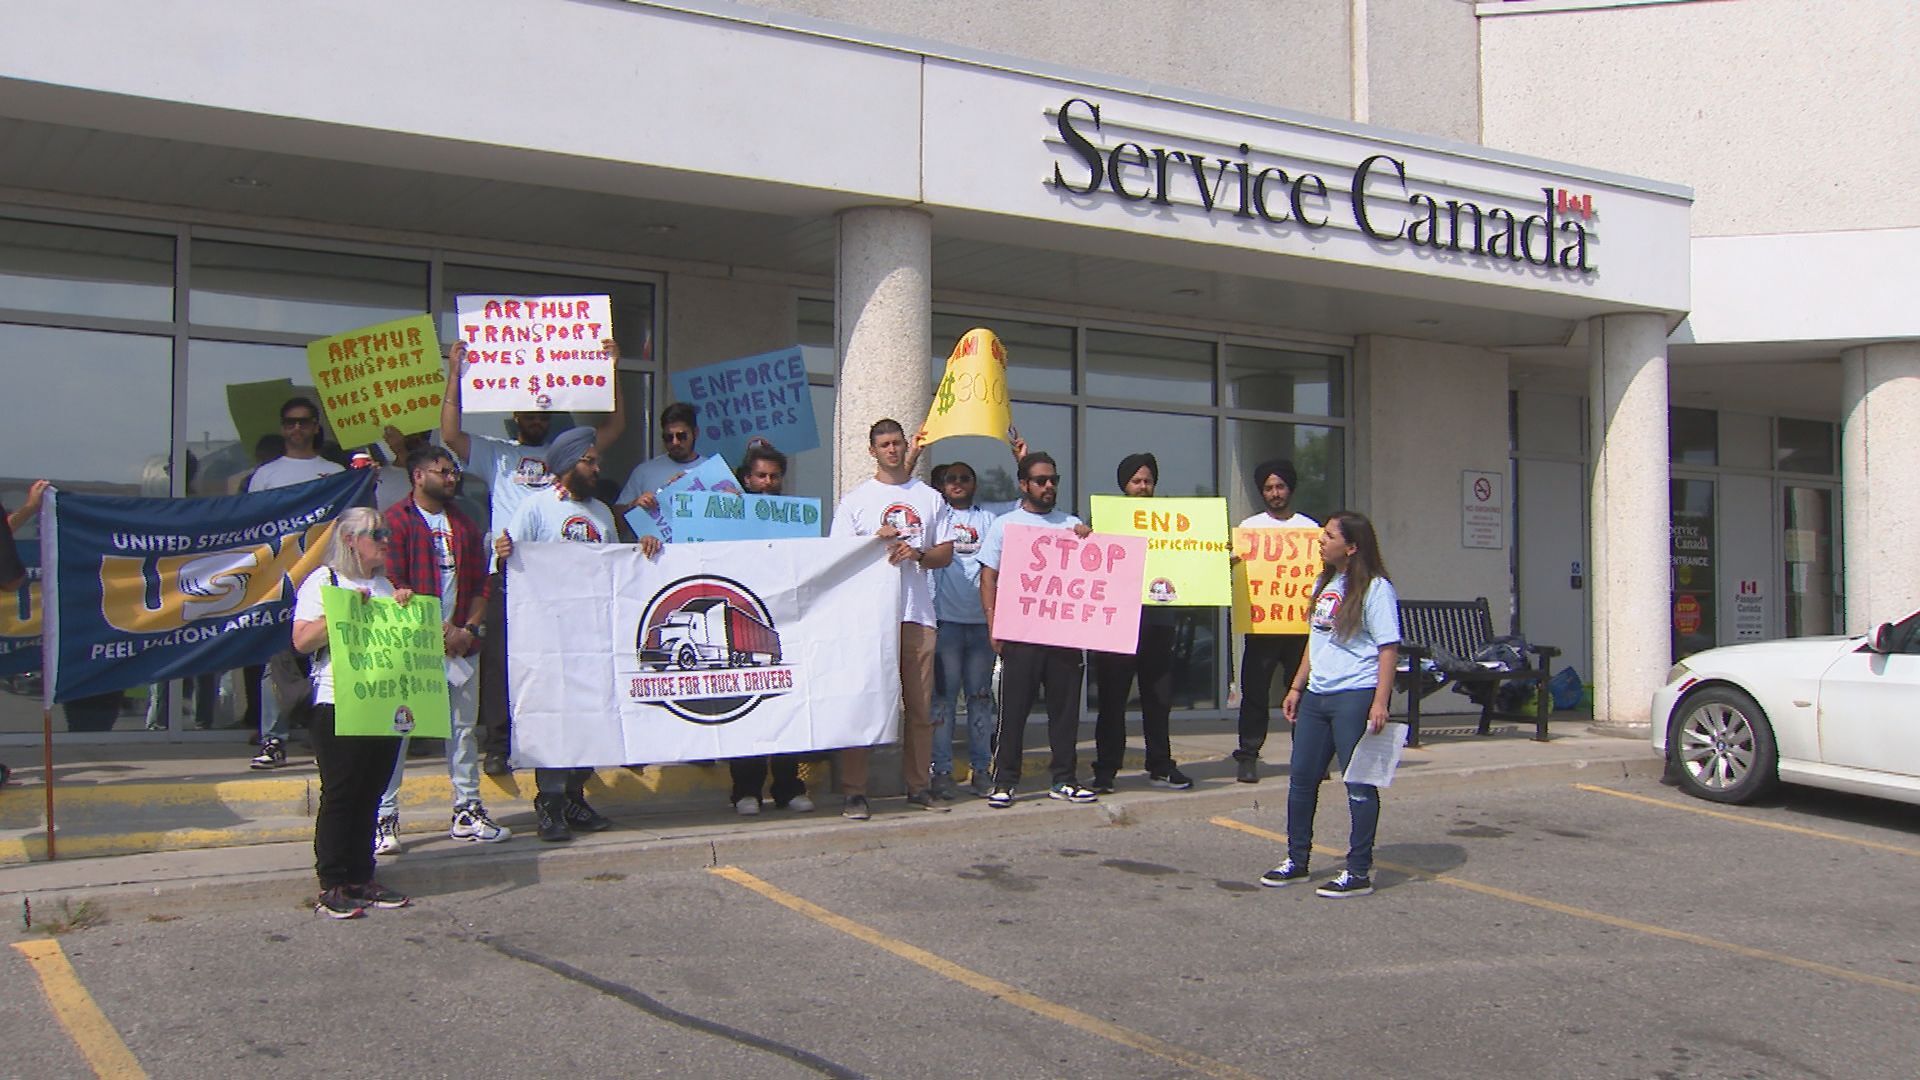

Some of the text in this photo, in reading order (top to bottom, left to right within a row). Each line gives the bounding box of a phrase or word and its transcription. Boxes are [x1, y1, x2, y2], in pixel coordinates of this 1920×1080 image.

[1053, 98, 1593, 273] Service Canada
[485, 300, 590, 319] ARTHUR
[328, 327, 422, 363] ARTHUR
[464, 323, 602, 343] TRANSPORT
[319, 349, 424, 388] TRANSPORT
[467, 350, 527, 365] OWES
[327, 387, 369, 410] OWES
[384, 368, 445, 394] WORKERS
[472, 377, 520, 390] OVER
[688, 355, 804, 400] ENFORCE
[337, 412, 366, 429] OVER
[706, 407, 798, 440] ORDERS
[676, 493, 818, 525] I AM OWED
[1133, 510, 1190, 532] END
[111, 531, 192, 551] UNITED
[1671, 523, 1699, 535] ervice
[1029, 535, 1126, 573] STOP
[1241, 531, 1318, 561] JUST
[1276, 565, 1314, 578] FOR
[1672, 556, 1709, 566] NTRANCE
[1020, 573, 1107, 600] WAGE
[1250, 581, 1313, 598] TRUC
[350, 595, 435, 626] ARTHUR
[1019, 597, 1117, 625] THEFT
[91, 639, 137, 660] PEEL
[224, 608, 274, 632] AREA
[336, 621, 435, 650] TRANSPORT
[349, 648, 393, 671] OWES
[354, 679, 397, 700] OVER
[630, 669, 793, 697] JUSTICE FOR TRUCK DRIVERS
